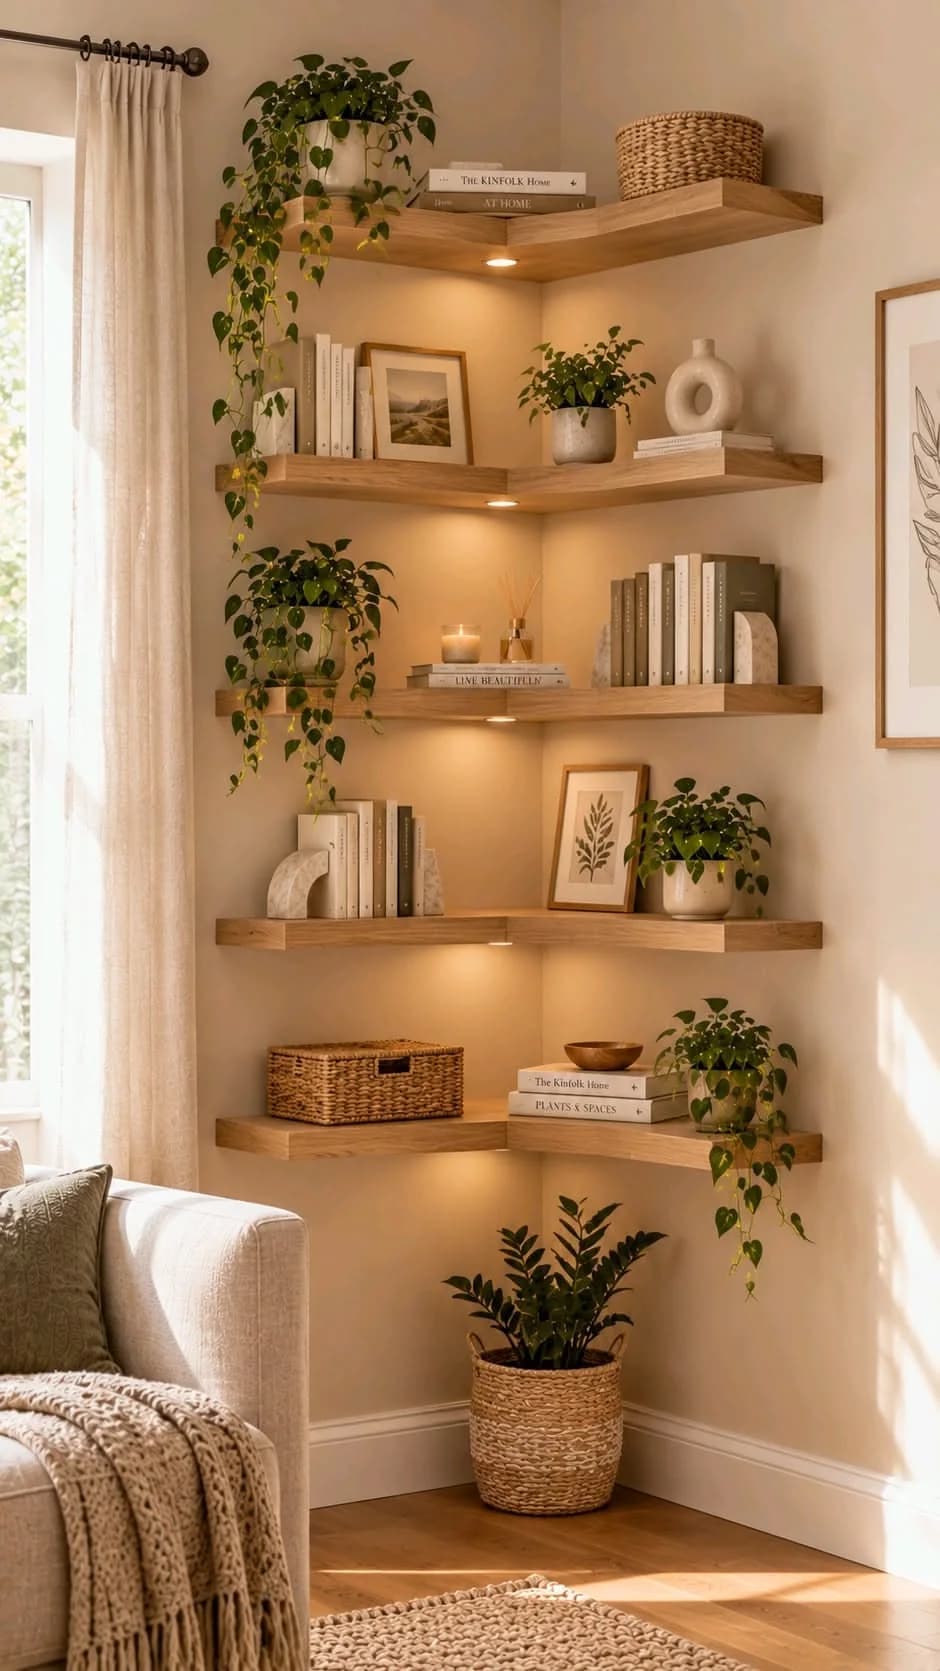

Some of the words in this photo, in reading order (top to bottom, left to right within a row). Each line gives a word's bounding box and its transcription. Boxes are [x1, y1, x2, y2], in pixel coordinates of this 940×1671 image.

[481, 175, 524, 186] KINFOLK
[501, 199, 532, 209] HOME
[535, 1077, 552, 1087] The
[553, 1078, 585, 1089] Kinfolk
[535, 1100, 572, 1112] PLANTS
[583, 1103, 617, 1114] SPACES
